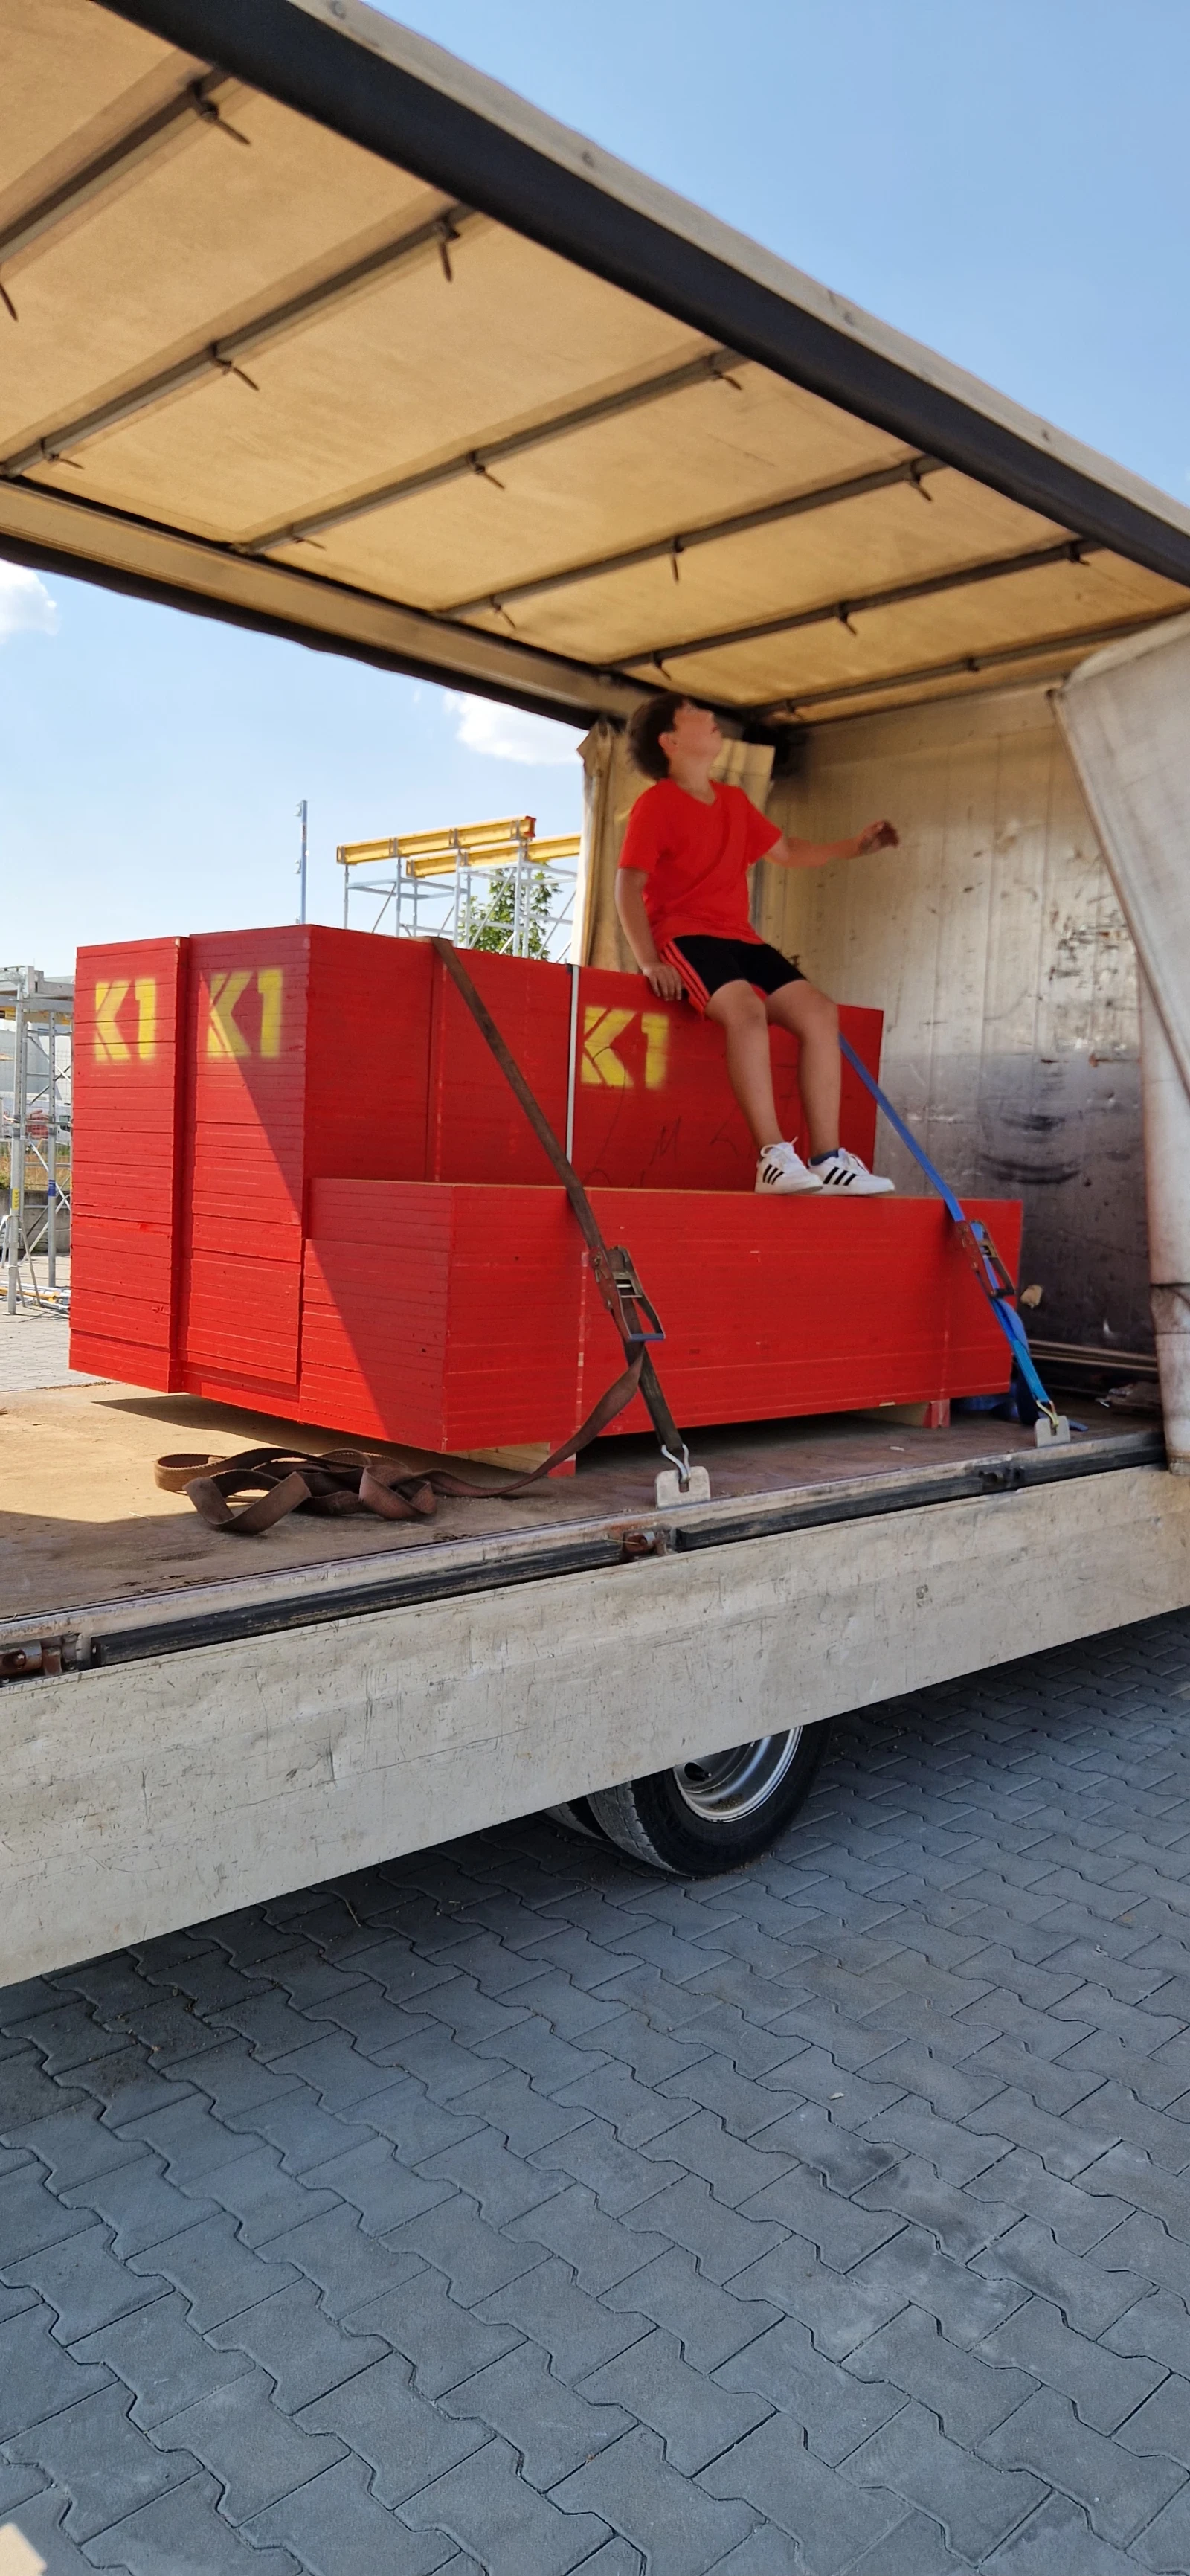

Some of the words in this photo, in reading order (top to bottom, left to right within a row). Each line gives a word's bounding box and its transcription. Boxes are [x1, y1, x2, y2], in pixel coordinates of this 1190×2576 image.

[94, 977, 158, 1062] K1
[207, 968, 283, 1059] K1
[580, 1006, 669, 1090] K1
